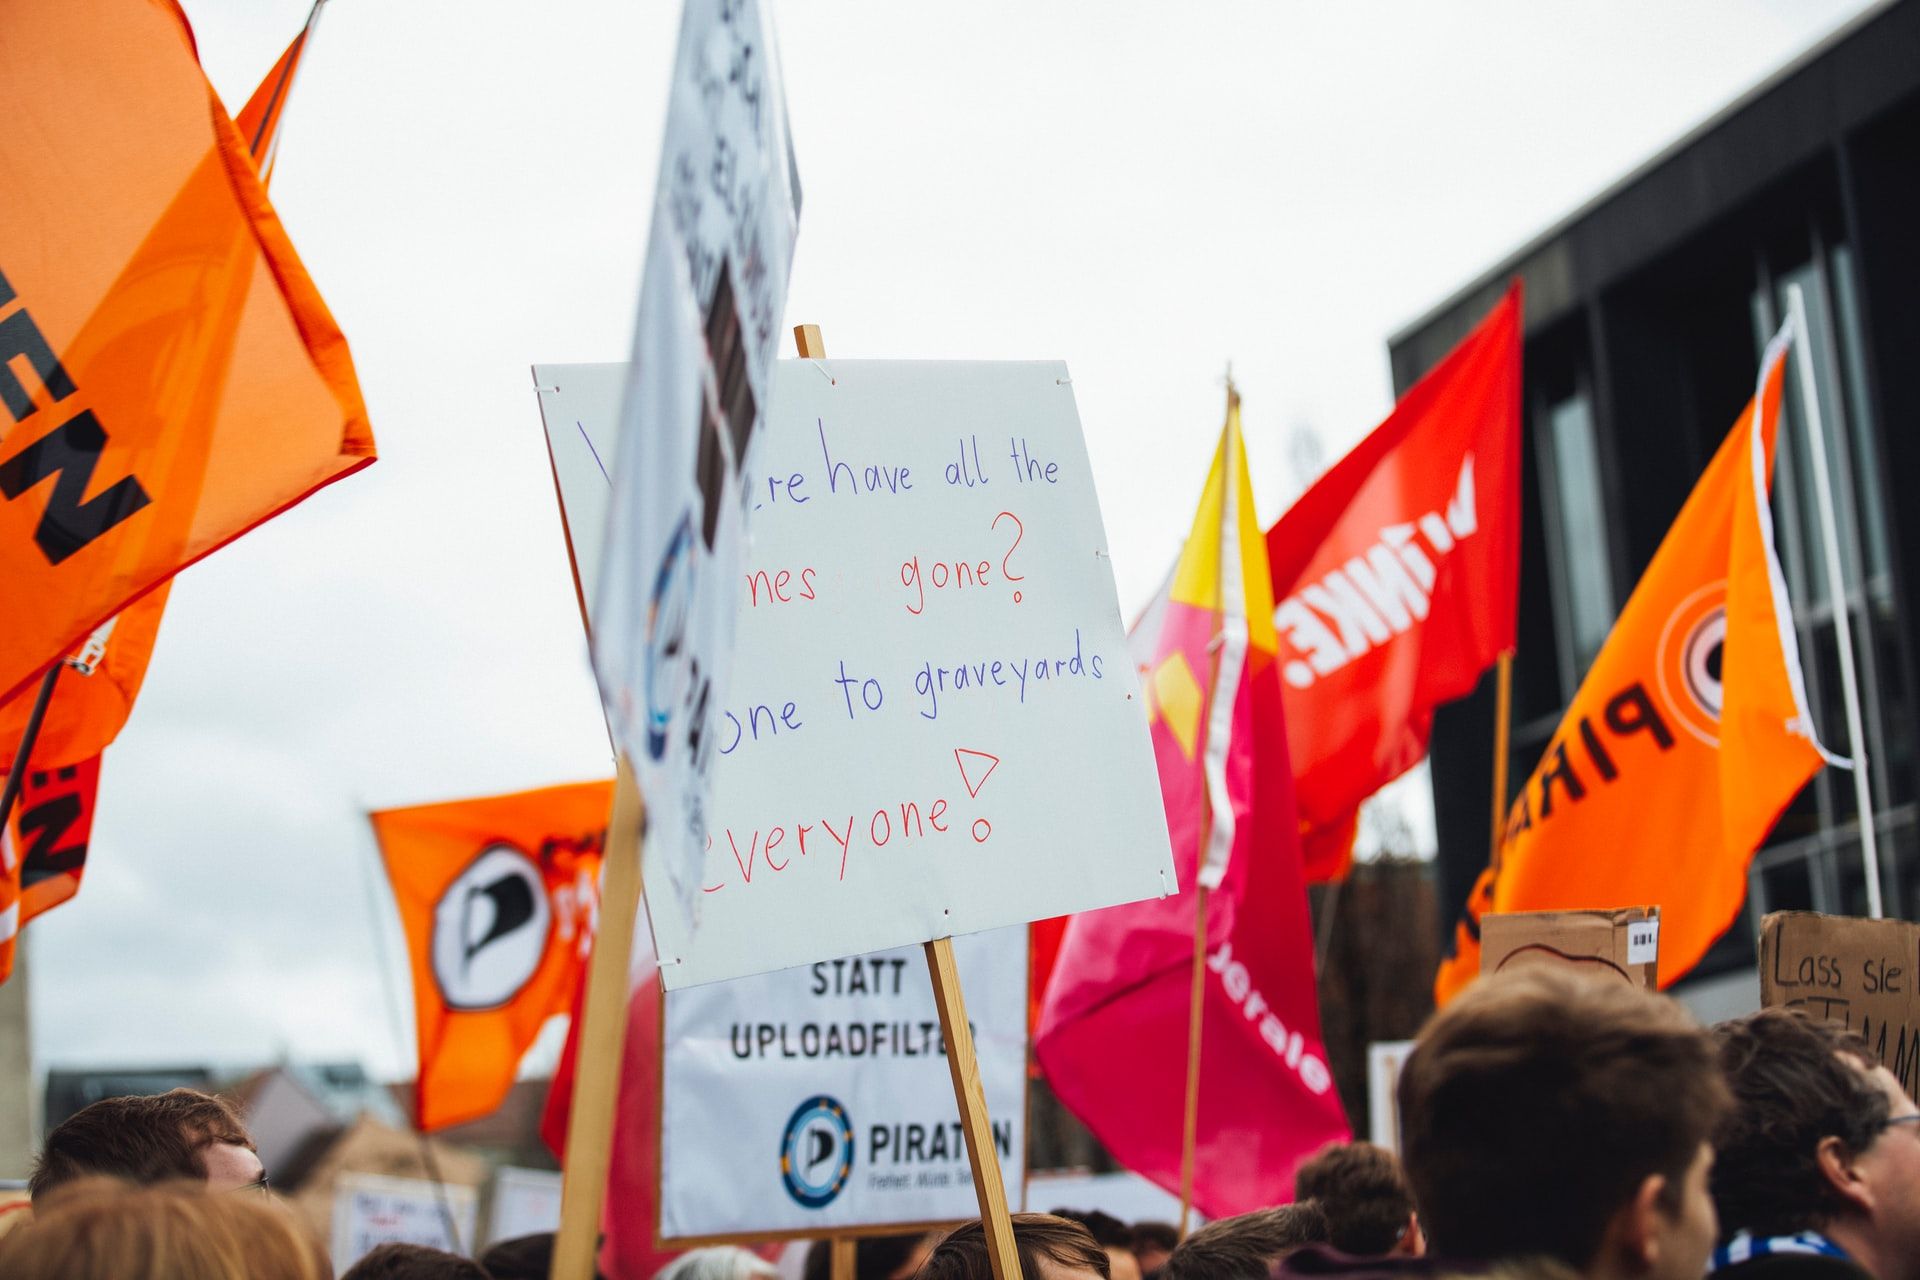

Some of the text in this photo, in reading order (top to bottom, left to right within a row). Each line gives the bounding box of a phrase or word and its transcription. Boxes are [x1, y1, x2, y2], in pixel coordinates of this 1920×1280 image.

[0, 266, 153, 567] EN
[818, 417, 913, 494] have
[945, 434, 989, 488] all
[1010, 437, 1058, 484] the
[901, 511, 1025, 615] gone?
[835, 661, 883, 719] to
[915, 629, 1104, 720] graveyards
[703, 749, 1000, 892] veryone!
[811, 957, 906, 996] STATT
[1775, 923, 1843, 989] Lass
[731, 1020, 976, 1058] UPLOADFILT
[869, 1118, 1012, 1163] PIRATN
